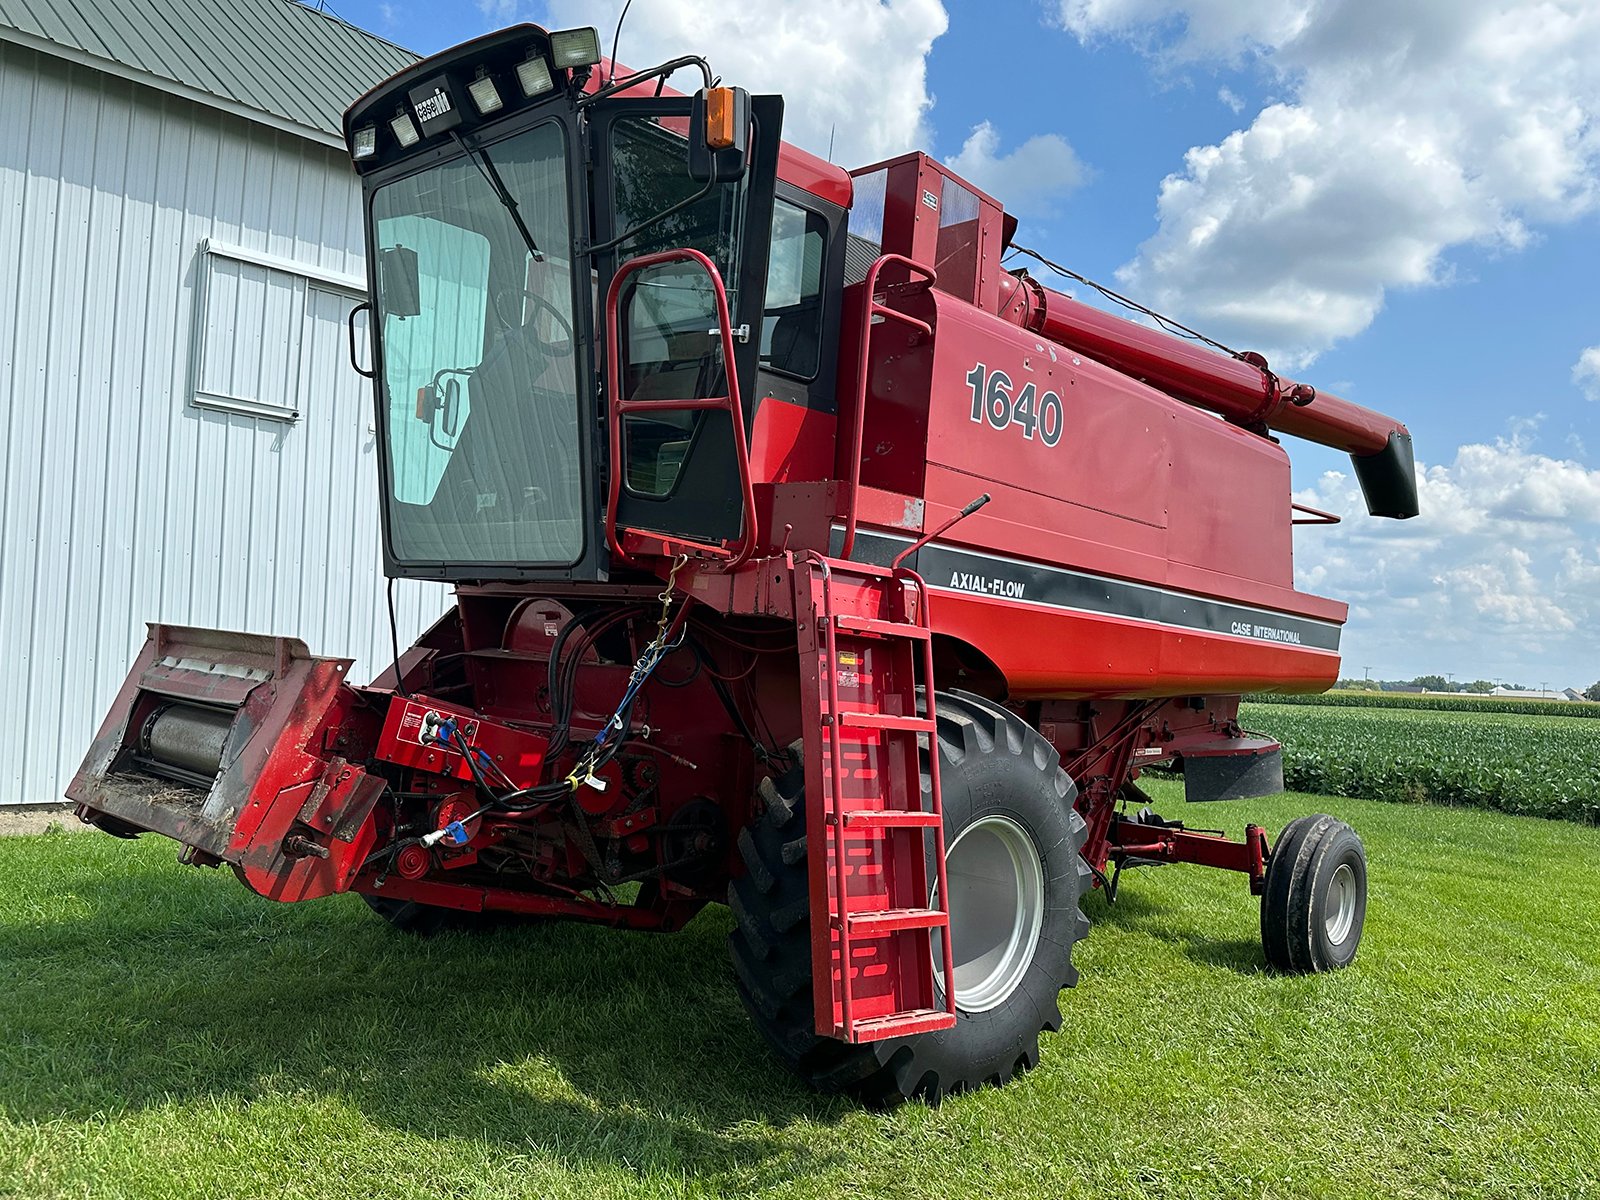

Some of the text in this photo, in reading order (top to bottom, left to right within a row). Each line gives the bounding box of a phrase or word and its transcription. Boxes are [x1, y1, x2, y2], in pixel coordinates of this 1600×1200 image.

[966, 361, 1064, 447] 1640
[950, 571, 1025, 598] AXIAL-FLOW
[1231, 621, 1301, 643] CASE INTERNATIONAL
